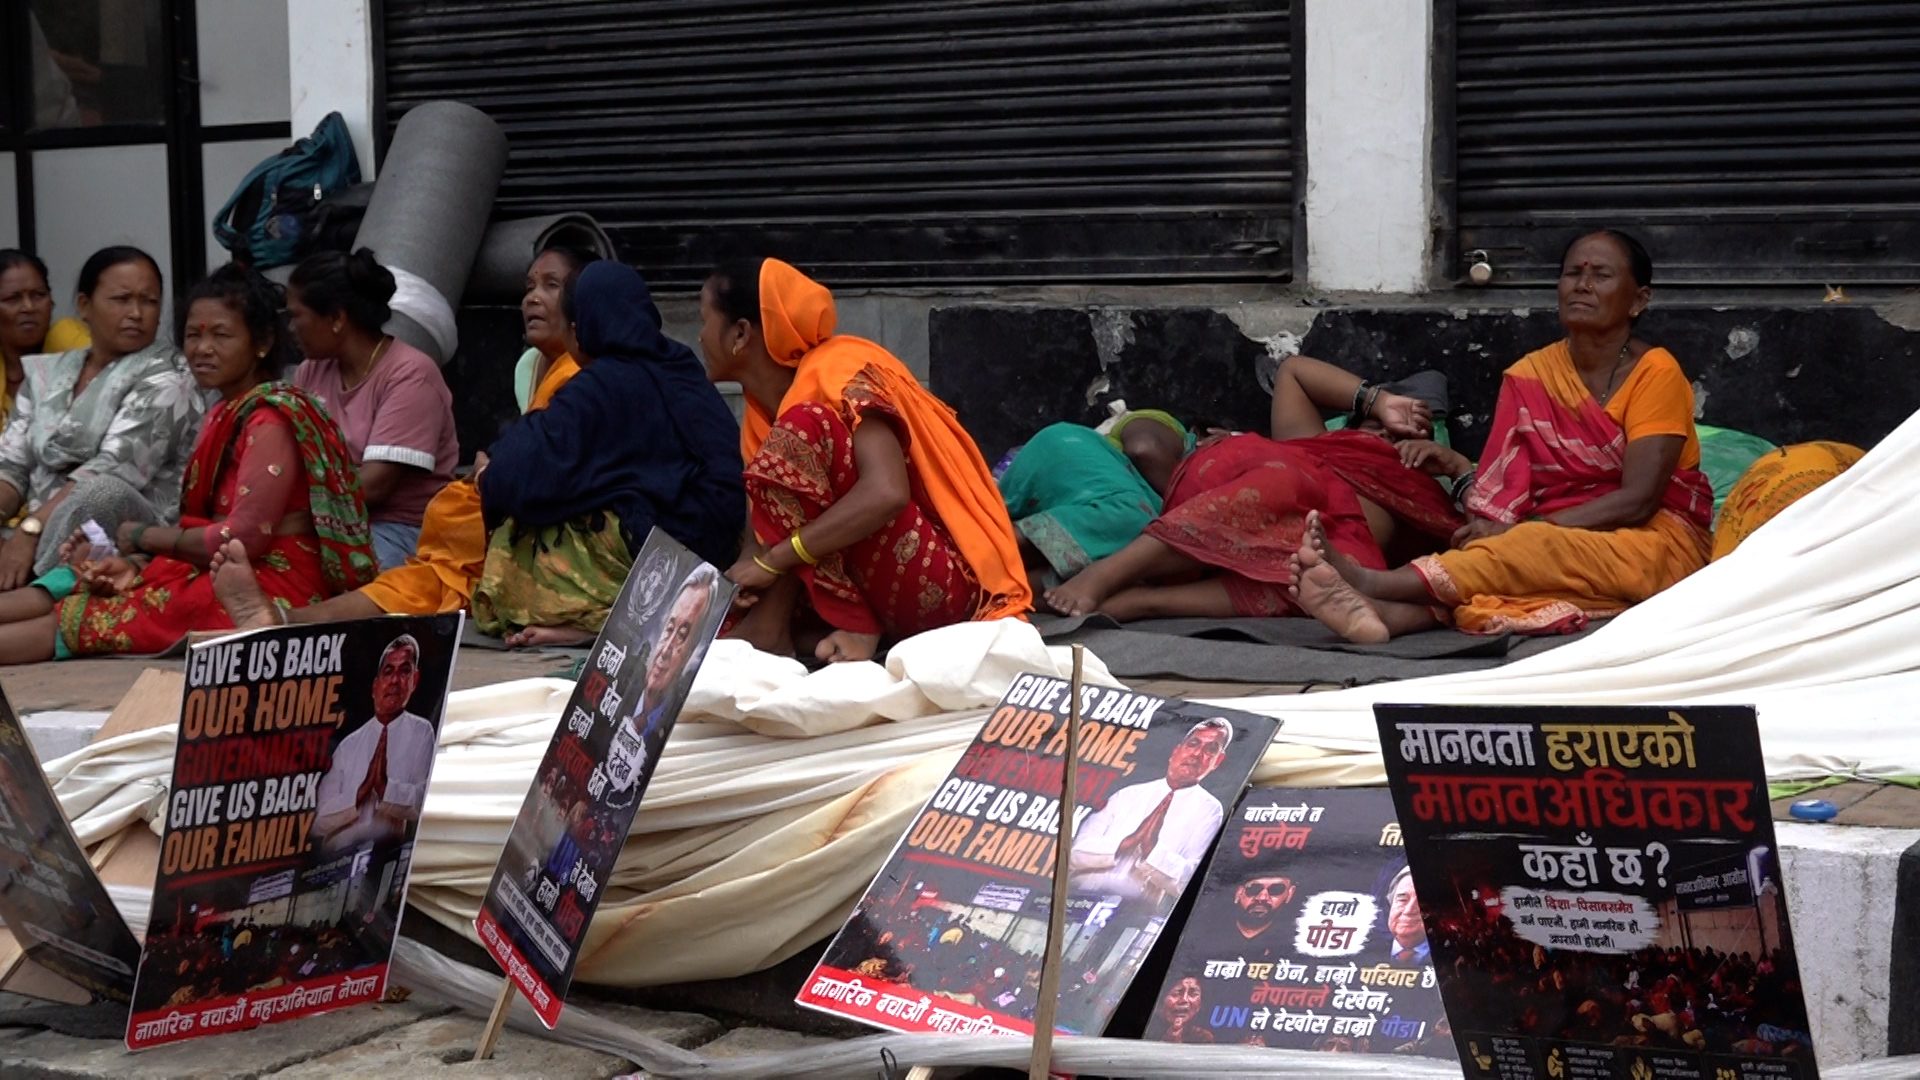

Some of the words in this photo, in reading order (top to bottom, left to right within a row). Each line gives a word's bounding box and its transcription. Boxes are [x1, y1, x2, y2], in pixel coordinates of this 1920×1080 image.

[189, 643, 244, 688] GIVE
[247, 637, 278, 682] US
[282, 633, 347, 680] BACK
[596, 639, 627, 679] हाम्रो
[183, 684, 250, 740] OUR
[253, 674, 346, 732] HOME,
[568, 705, 595, 740] हाम्रो
[1006, 675, 1068, 712] GIVE
[1090, 689, 1165, 730] BACK
[981, 706, 1055, 750] OUR
[1396, 722, 1537, 767] मानवता
[1541, 711, 1698, 769] हराएको
[170, 785, 224, 829] GIVE
[227, 780, 257, 822] US
[260, 771, 322, 817] BACK
[933, 778, 996, 817] GIVE
[985, 789, 1027, 824] US
[1244, 802, 1309, 822] बालेनले
[1309, 806, 1325, 822] त
[1407, 767, 1756, 832] मानवअधिकार
[162, 825, 218, 875] OUR
[221, 811, 314, 868] FAMILY.
[908, 811, 974, 856] OUR
[1239, 820, 1312, 858] सुनेन
[1518, 831, 1599, 887] कहाँ
[1320, 898, 1359, 917] हाम्रो
[810, 976, 878, 1008] नागरिक
[1203, 957, 1246, 980] हाम्रो
[1247, 962, 1273, 981] घर
[1275, 959, 1309, 984] छैन,
[1314, 961, 1358, 985] हाम्रो
[1360, 963, 1420, 988] परिवार
[134, 1007, 197, 1041] नागरिक
[338, 974, 378, 1000] नेपाल
[1209, 1005, 1248, 1029] UN
[1251, 1008, 1270, 1029] ले
[1273, 1010, 1331, 1034] देखोस
[1332, 1012, 1378, 1038] हाम्रो
[1251, 983, 1330, 1008] नेपालले
[1332, 984, 1393, 1015] देखेन;
